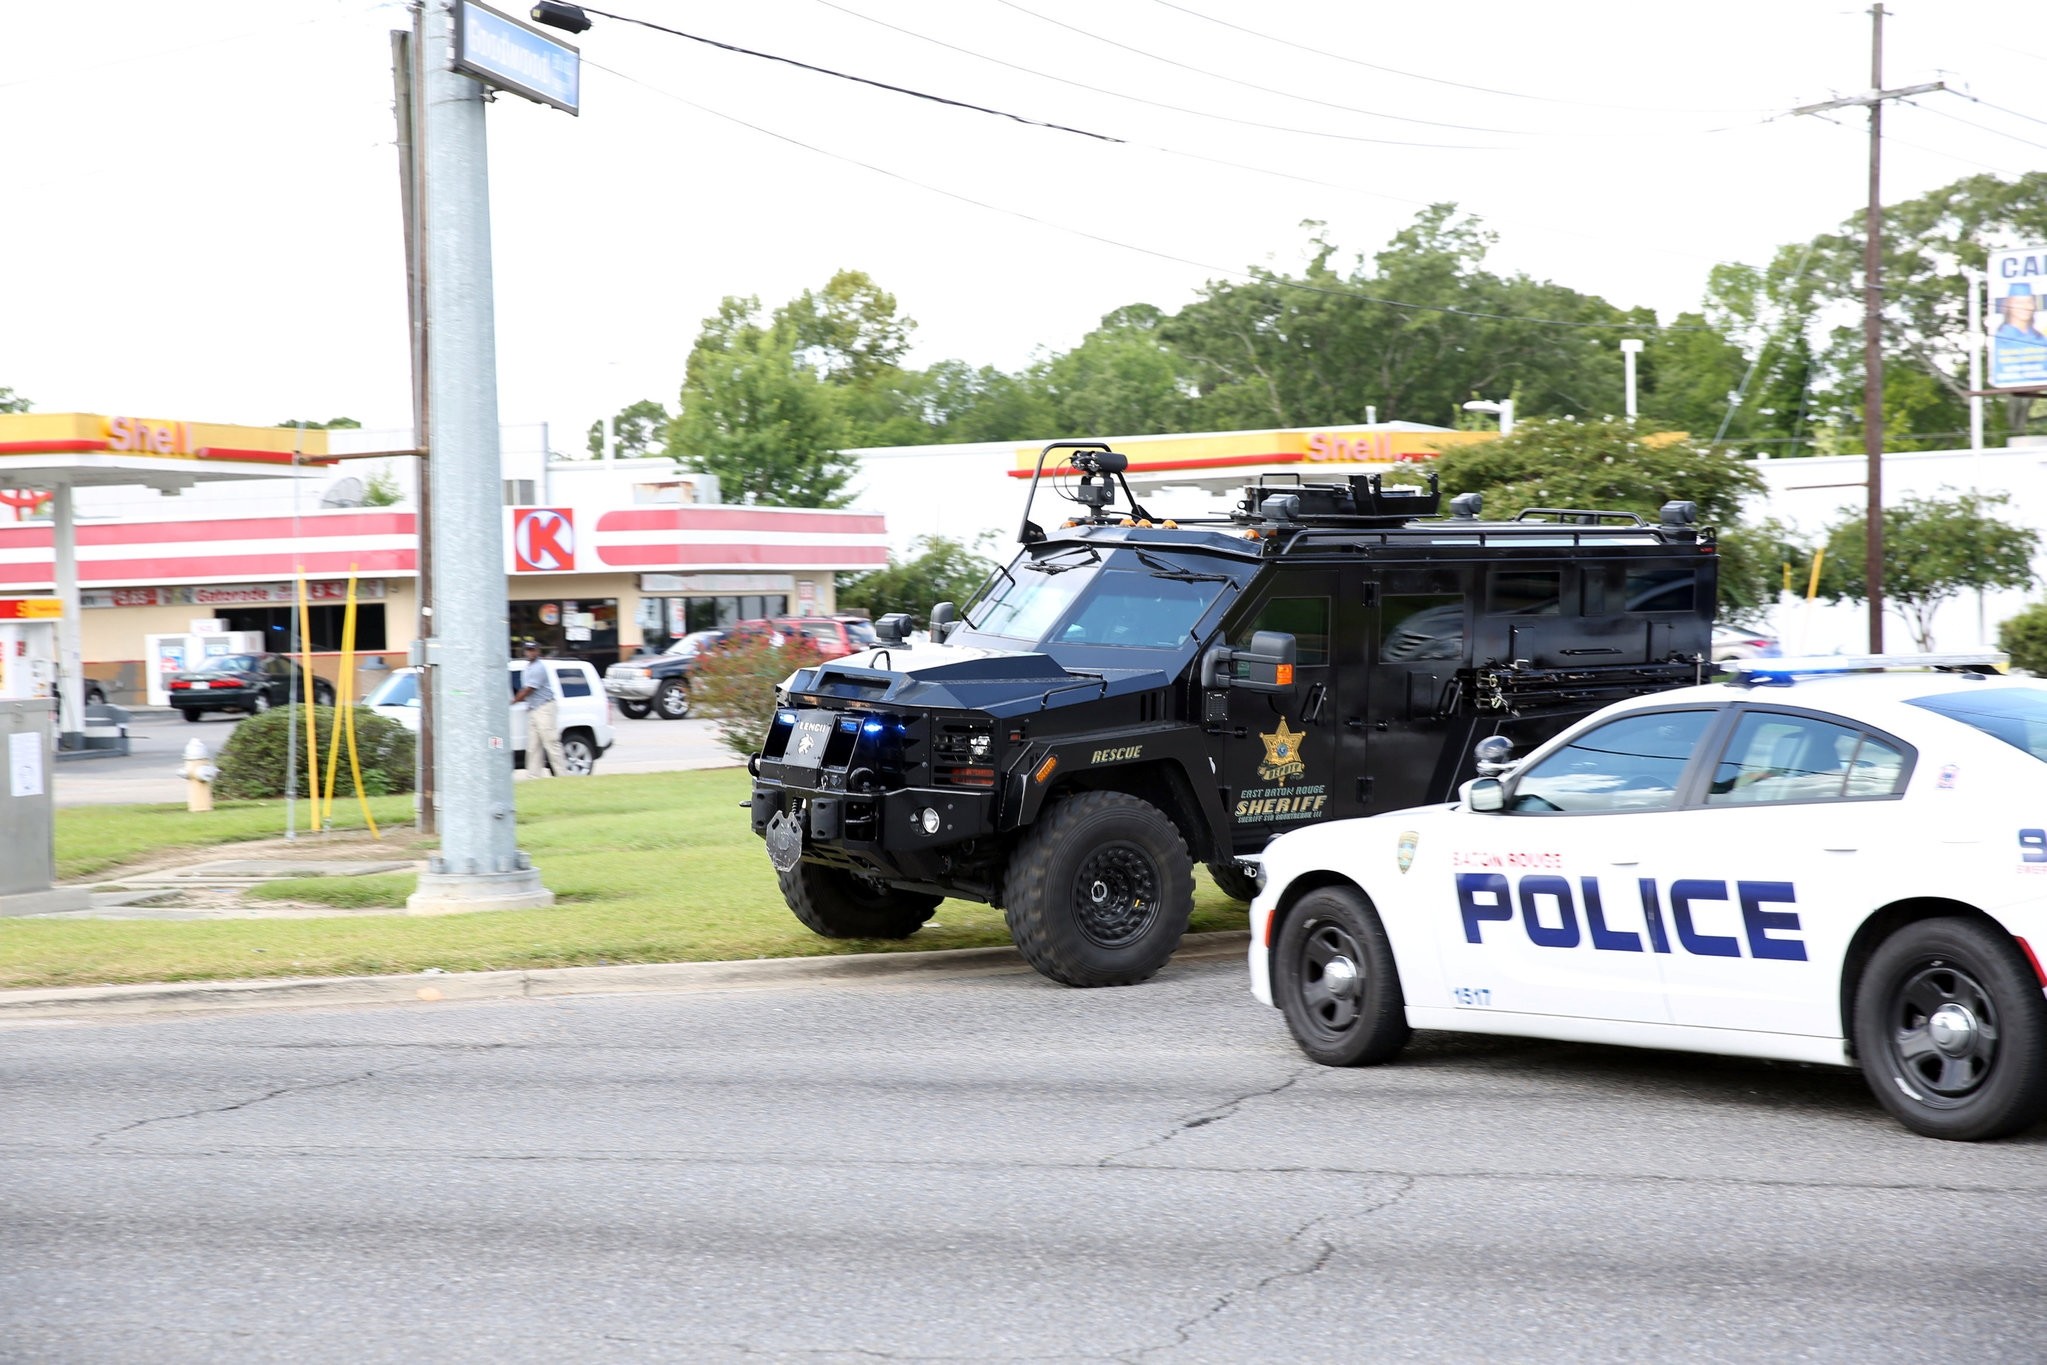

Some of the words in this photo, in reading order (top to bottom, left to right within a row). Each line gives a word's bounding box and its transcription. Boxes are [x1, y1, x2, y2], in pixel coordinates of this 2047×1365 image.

[2001, 255, 2047, 279] CA
[111, 416, 193, 454] Shell
[1309, 432, 1391, 461] Shell
[528, 515, 575, 571] K
[197, 587, 269, 603] Gatorade
[1091, 744, 1143, 765] RESCUE
[1241, 789, 1264, 799] EAST
[1265, 787, 1294, 797] BATON
[1296, 785, 1325, 795] ROUGE
[1235, 795, 1328, 817] SHERIFF
[1237, 815, 1263, 824] SHERIFF
[1508, 852, 1562, 868] ROUGE
[1455, 872, 1809, 962] POLICE
[1452, 986, 1493, 1006] 1517
